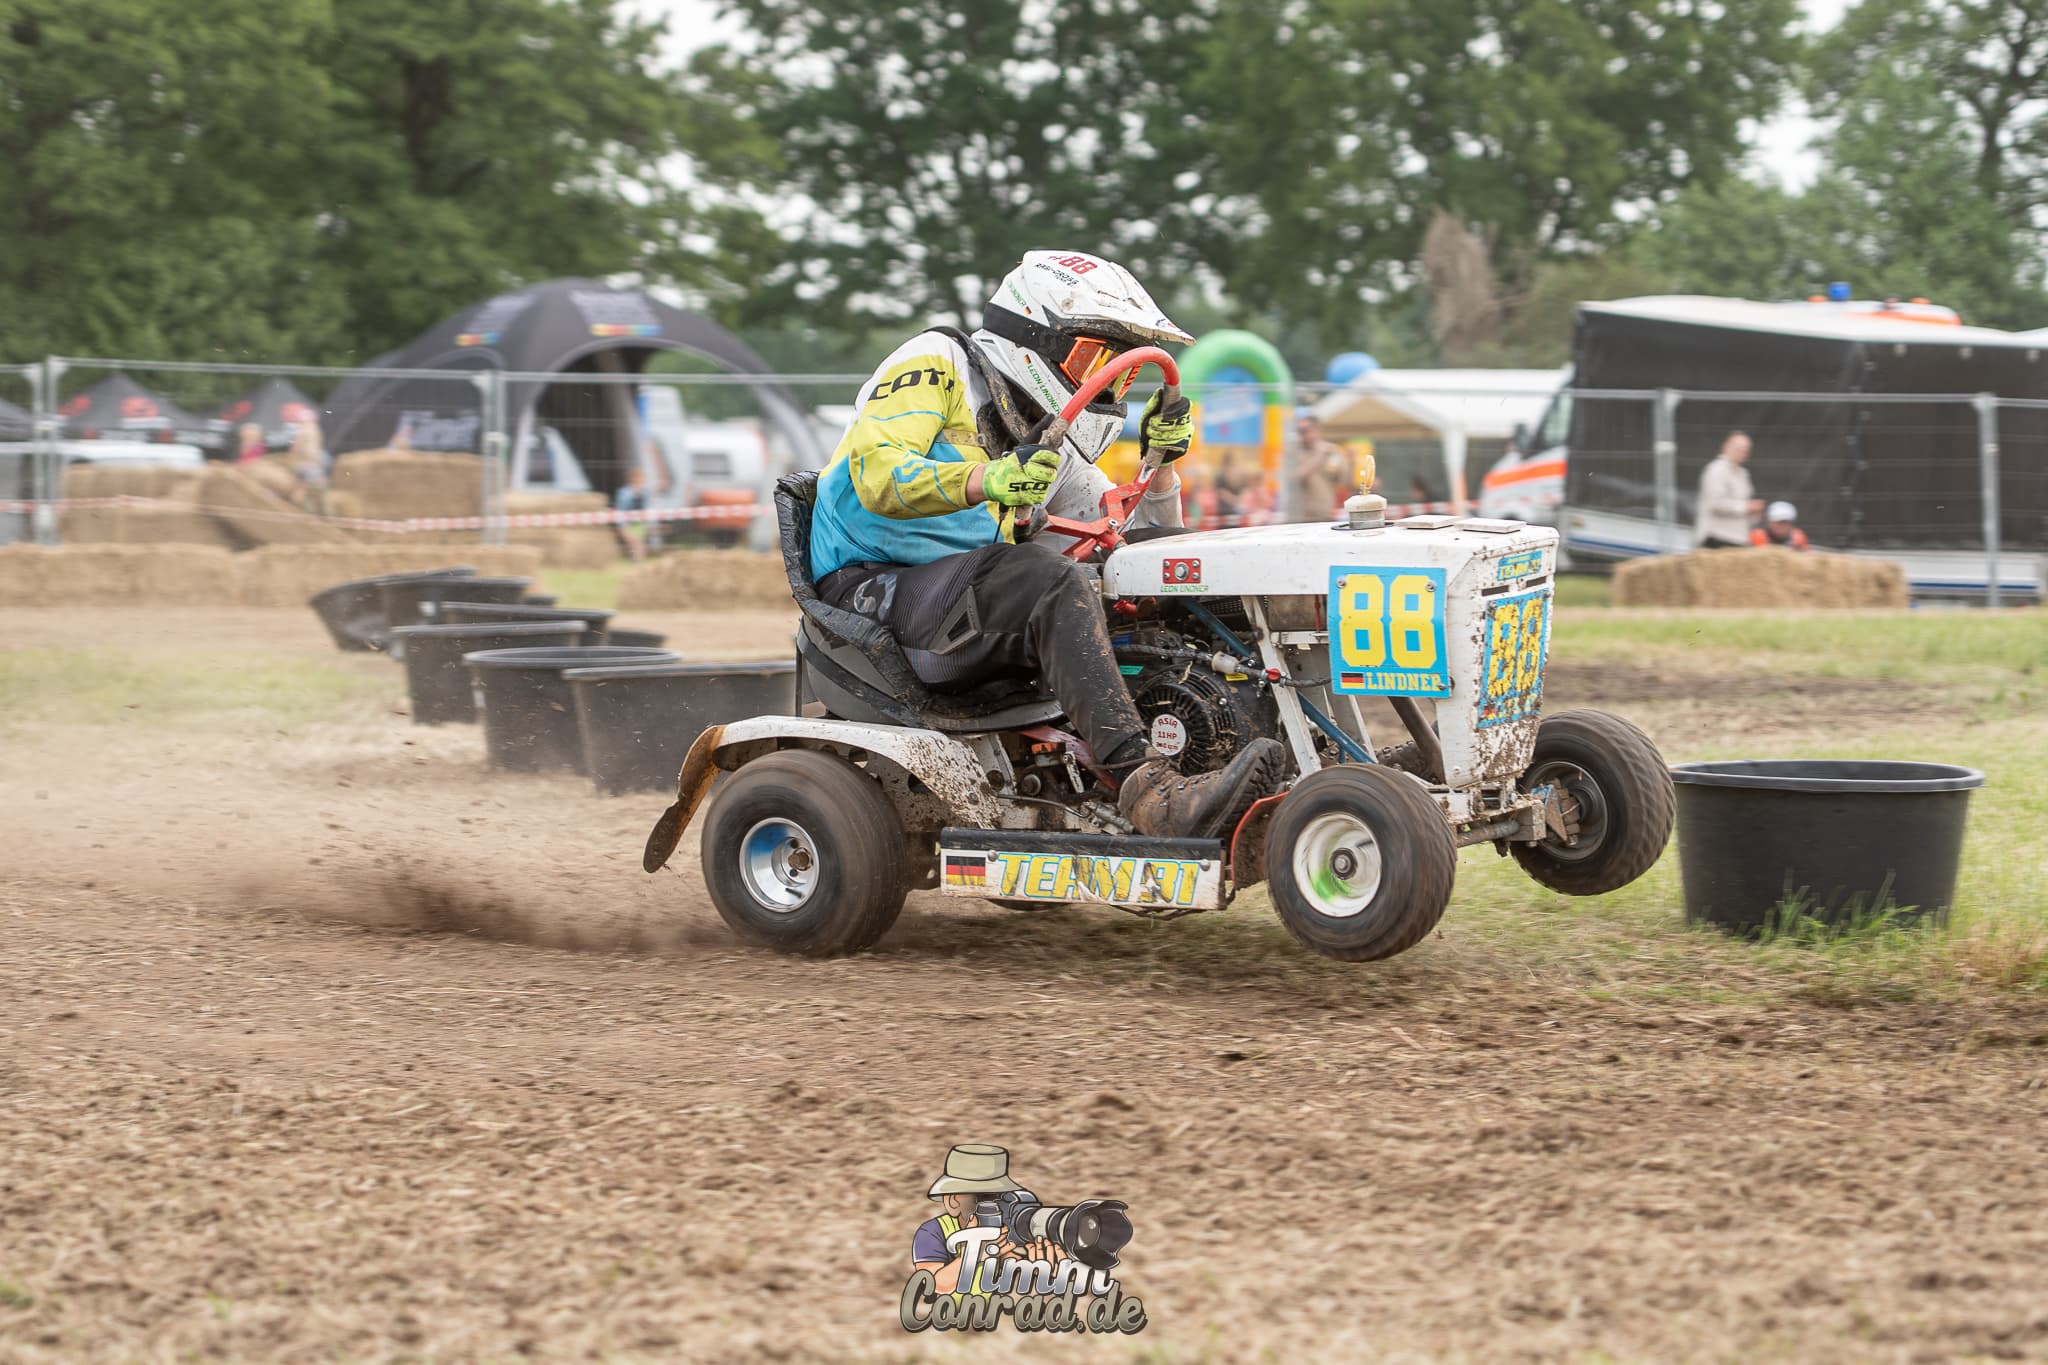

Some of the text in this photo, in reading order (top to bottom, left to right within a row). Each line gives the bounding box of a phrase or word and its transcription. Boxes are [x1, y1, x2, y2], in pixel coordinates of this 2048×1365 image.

[1027, 364, 1043, 385] LEON
[1338, 573, 1438, 670] 88
[1487, 597, 1543, 698] 88
[1366, 671, 1444, 692] LINDNER
[1157, 717, 1178, 729] ASIA
[998, 850, 1137, 902] TEAM
